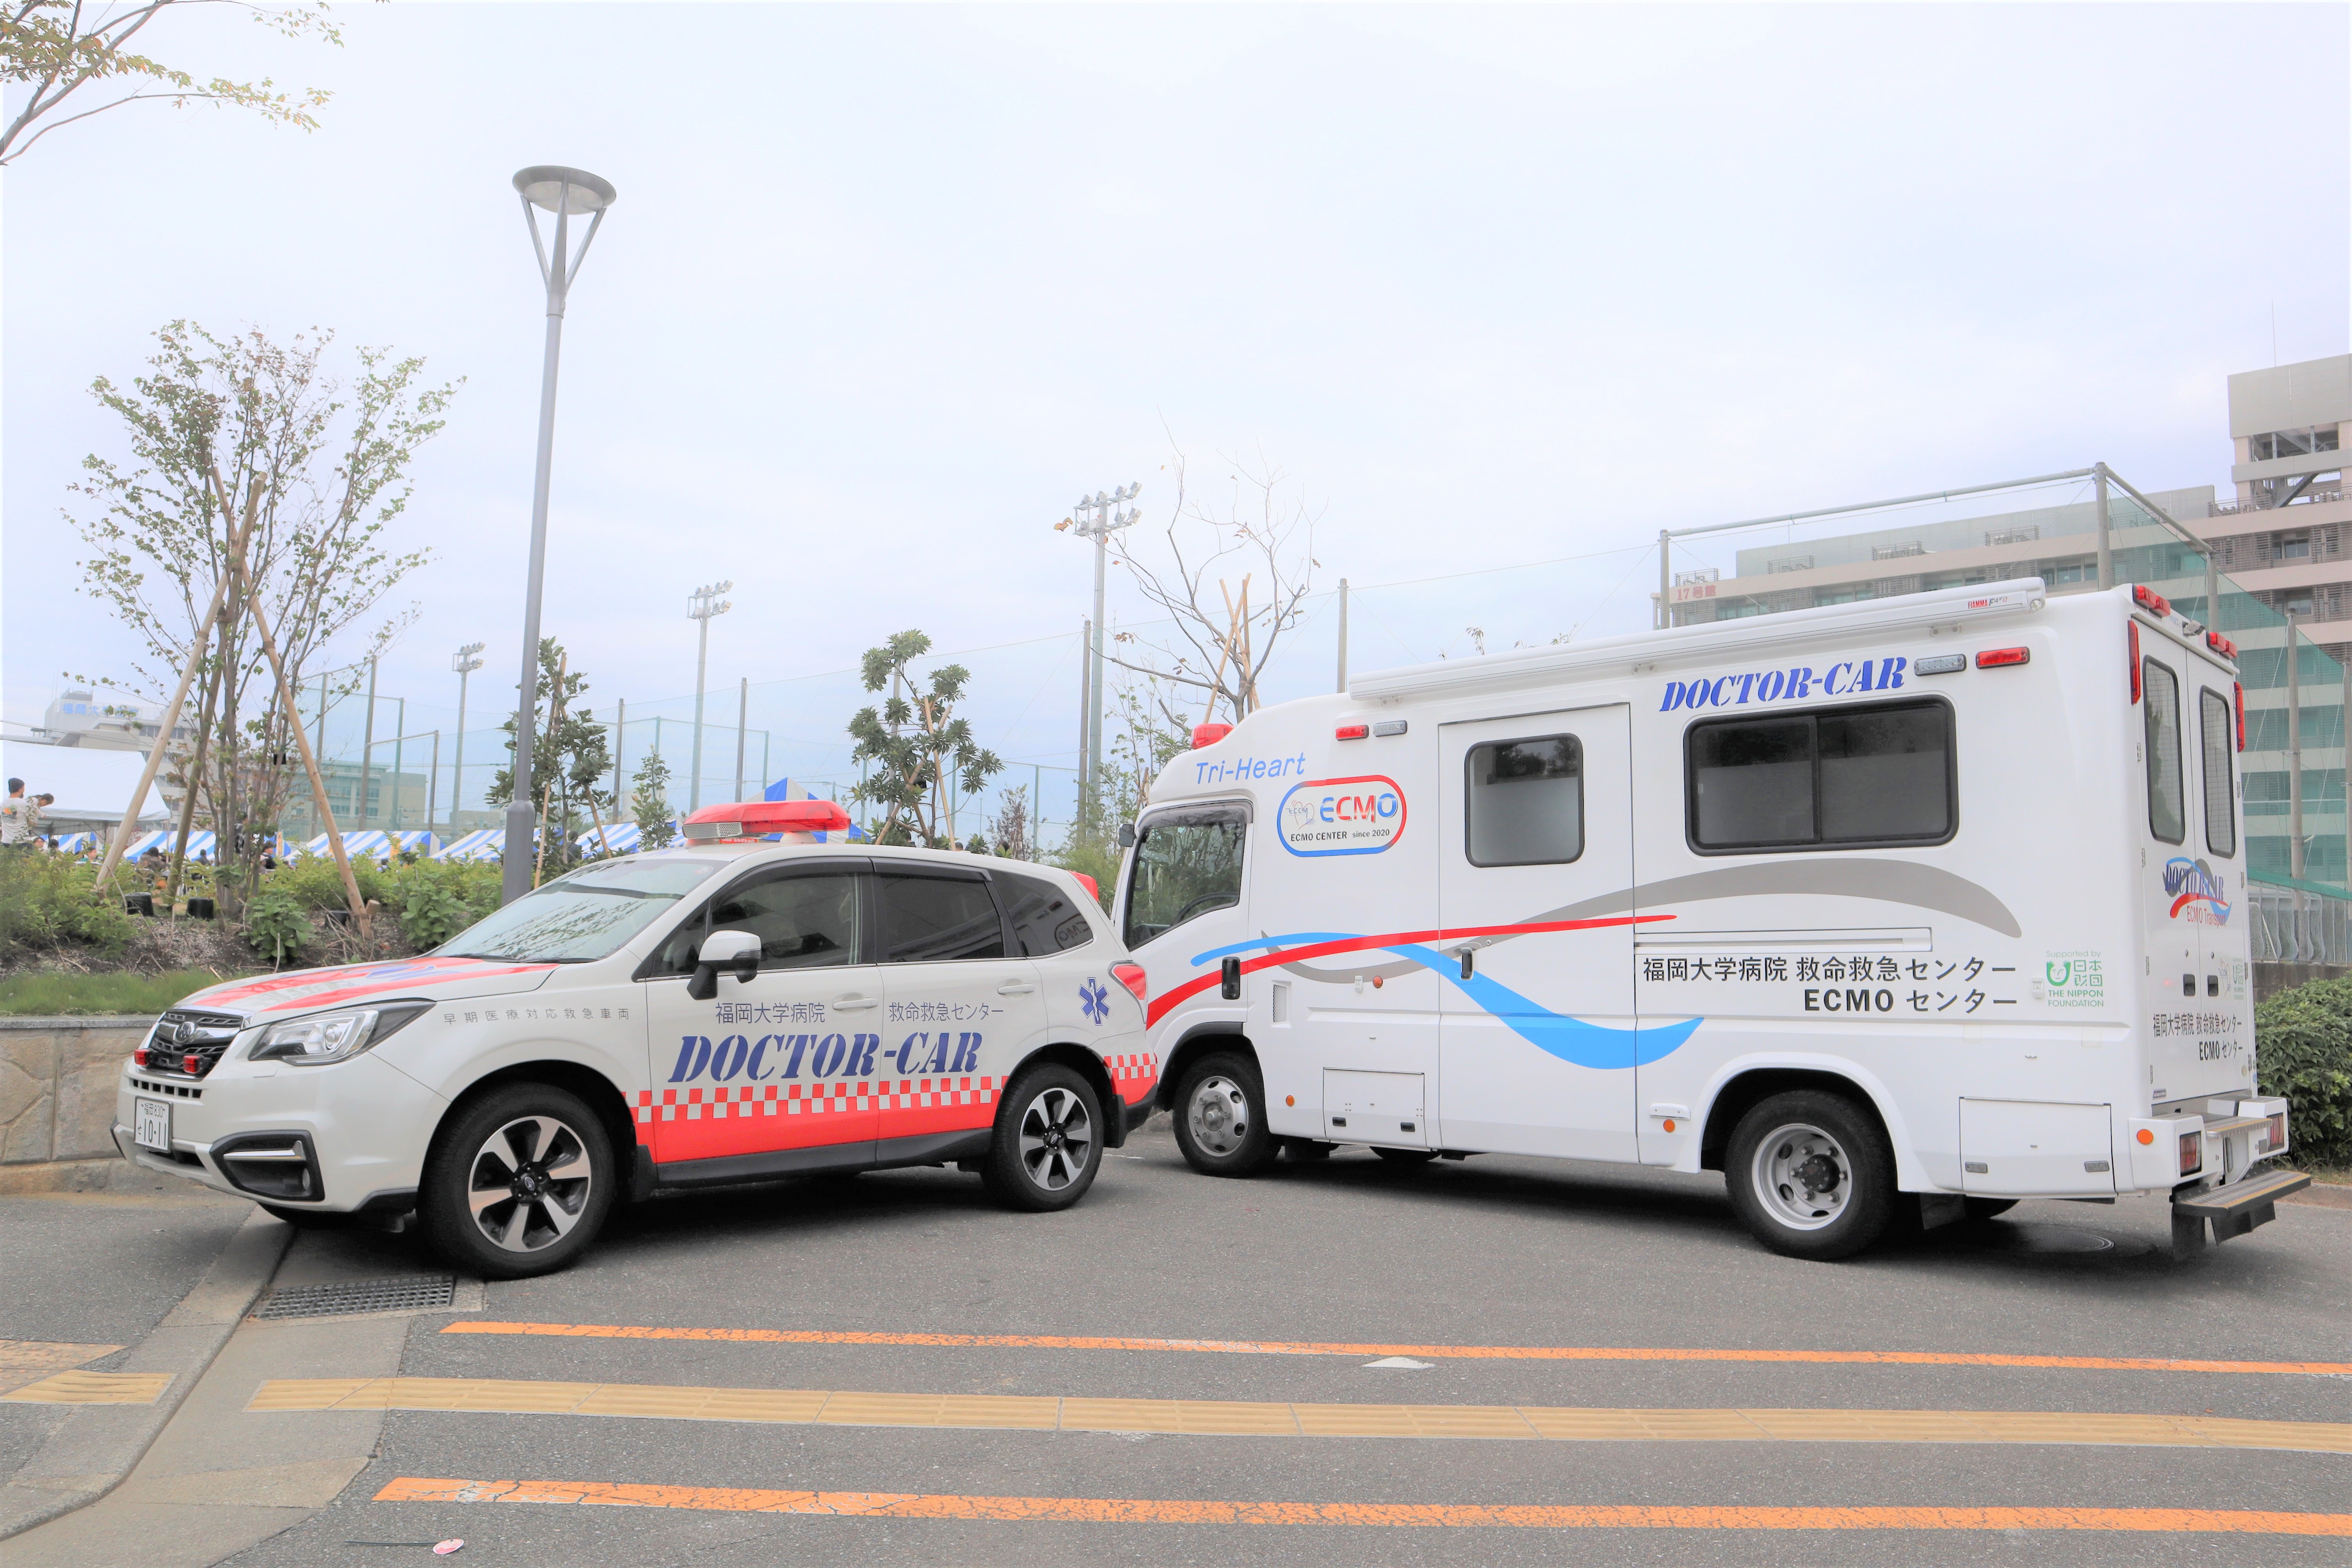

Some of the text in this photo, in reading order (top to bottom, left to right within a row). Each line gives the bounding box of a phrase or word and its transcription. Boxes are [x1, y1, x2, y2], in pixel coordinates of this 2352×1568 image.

[1677, 584, 1716, 600] 17号館
[1968, 599, 1988, 609] FIAMMA
[1659, 657, 1907, 711] DOCTOR-CAR
[63, 702, 139, 719] 福岡大
[1196, 752, 1306, 784] Tri-Heart
[1320, 793, 1398, 823] ECMO
[1291, 833, 1313, 841] ECMO
[1316, 831, 1347, 840] CENTER
[2187, 905, 2226, 929] ECMO Transport
[2046, 950, 2089, 958] Supported
[1643, 956, 2016, 982] 福岡大学病院 救命救急センター
[2074, 960, 2102, 972] 日本
[1804, 988, 2017, 1013] ECMO センター
[443, 1008, 629, 1025] 早期医療対応救急車両
[716, 1002, 1004, 1024] 福岡大学病院 救命救急センター
[2153, 1013, 2241, 1037] 福岡大学病院 救命救急センター
[668, 1032, 982, 1083] DOCTOR-CAR
[2199, 1039, 2243, 1060] ECMO センター
[154, 1104, 163, 1118] 830
